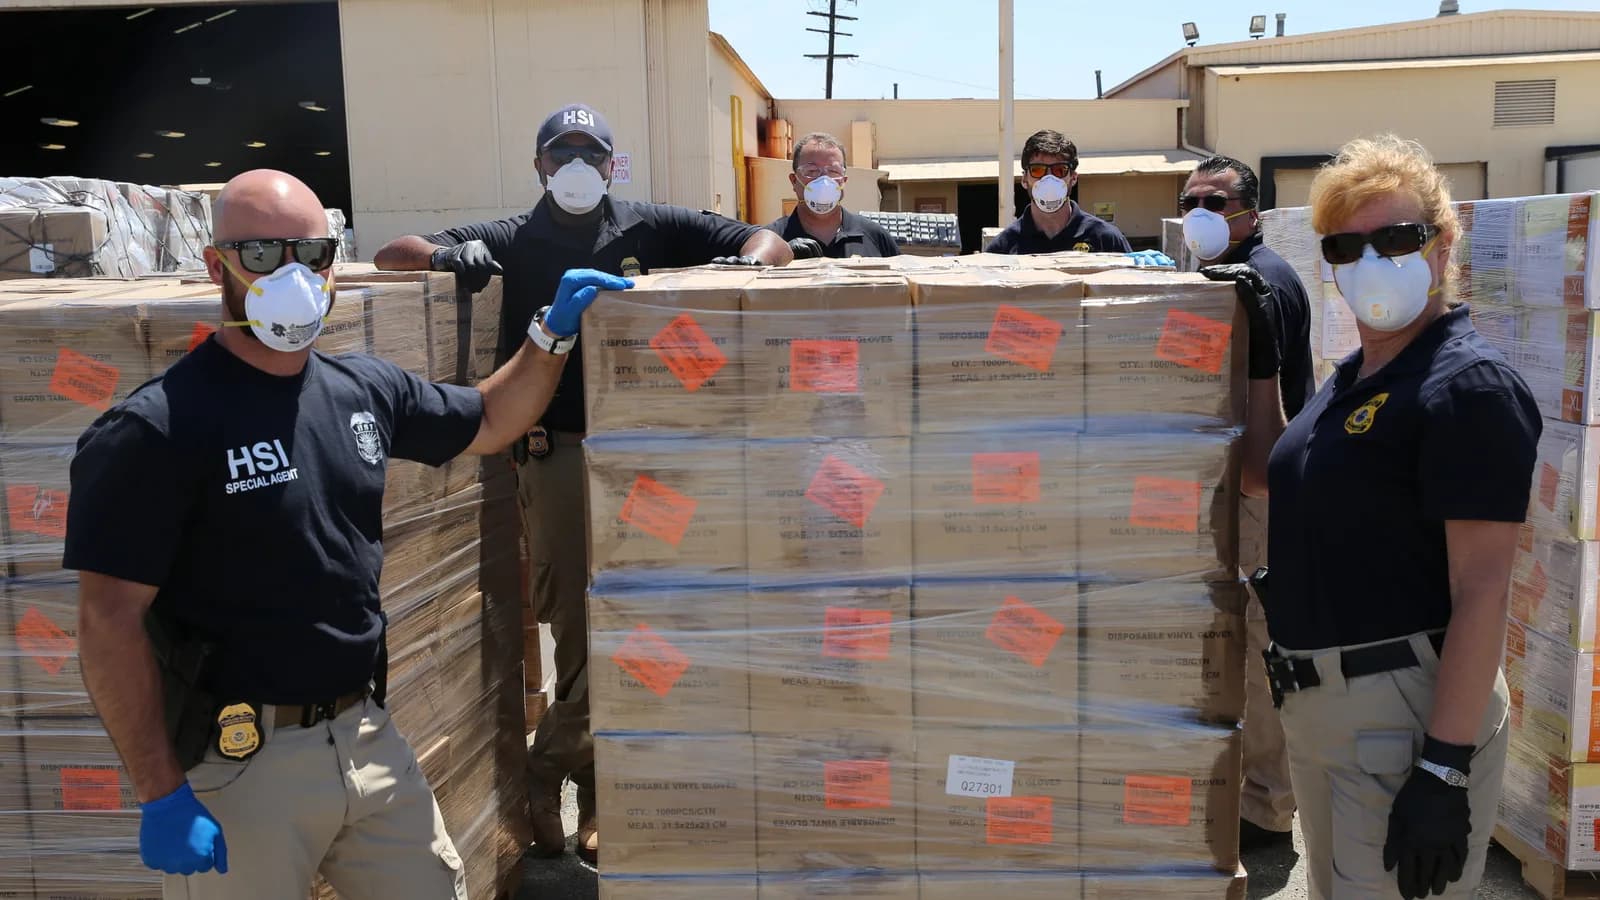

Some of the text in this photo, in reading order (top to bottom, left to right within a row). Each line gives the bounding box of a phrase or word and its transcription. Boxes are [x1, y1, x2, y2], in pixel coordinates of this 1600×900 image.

[563, 110, 595, 127] HSI
[226, 439, 290, 479] HSI
[225, 468, 299, 494] SPECIAL AGENT
[1107, 632, 1166, 641] DISPOSABLE
[1167, 631, 1194, 640] VINYL
[615, 782, 670, 791] DISPOSABLE
[961, 780, 1003, 794] Q27301
[712, 820, 728, 829] CM
